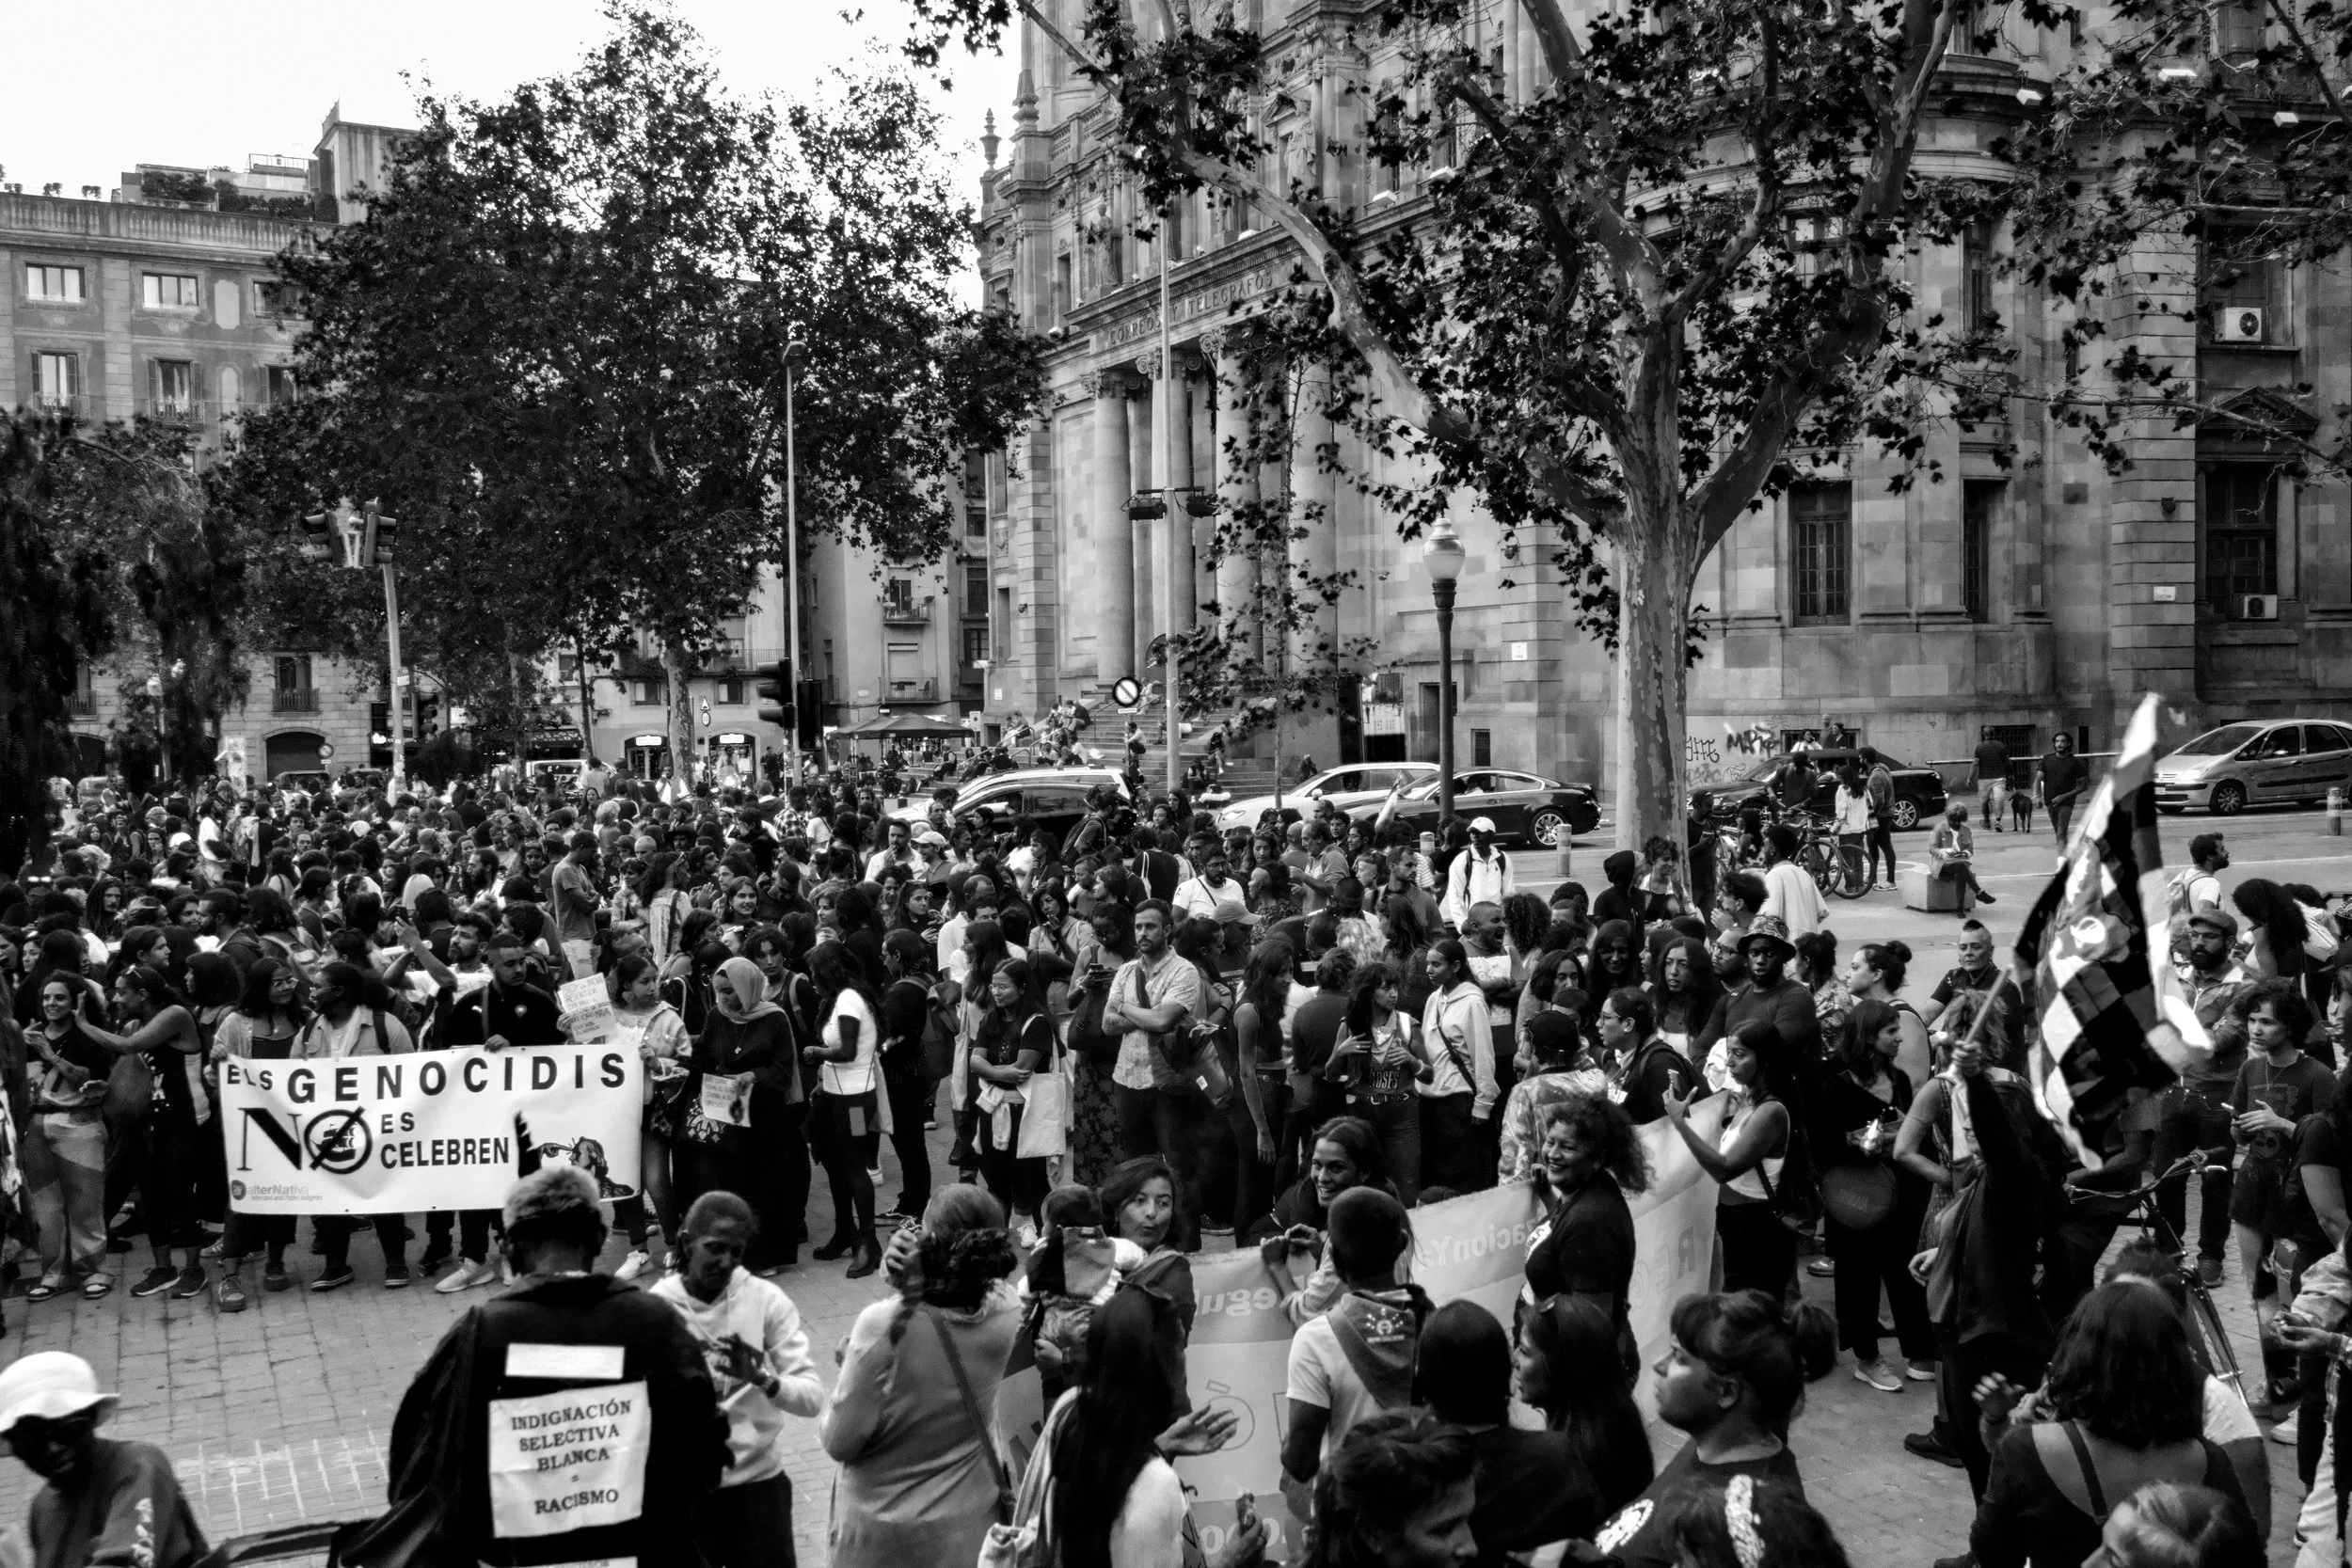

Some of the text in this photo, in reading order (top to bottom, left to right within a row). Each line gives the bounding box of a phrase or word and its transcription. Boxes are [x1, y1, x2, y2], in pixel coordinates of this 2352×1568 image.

[1110, 272, 1274, 344] CORREOS Y TELEGRAFOS
[227, 1053, 625, 1103] ELS GENOCIDIS
[381, 1112, 415, 1134] ES
[381, 1137, 509, 1169] CELEBREN
[511, 1399, 632, 1430] INDIGNACIÓN
[519, 1424, 621, 1452] SELECTIVA
[537, 1448, 610, 1472] BLANCA
[534, 1489, 619, 1513] RACISMO
